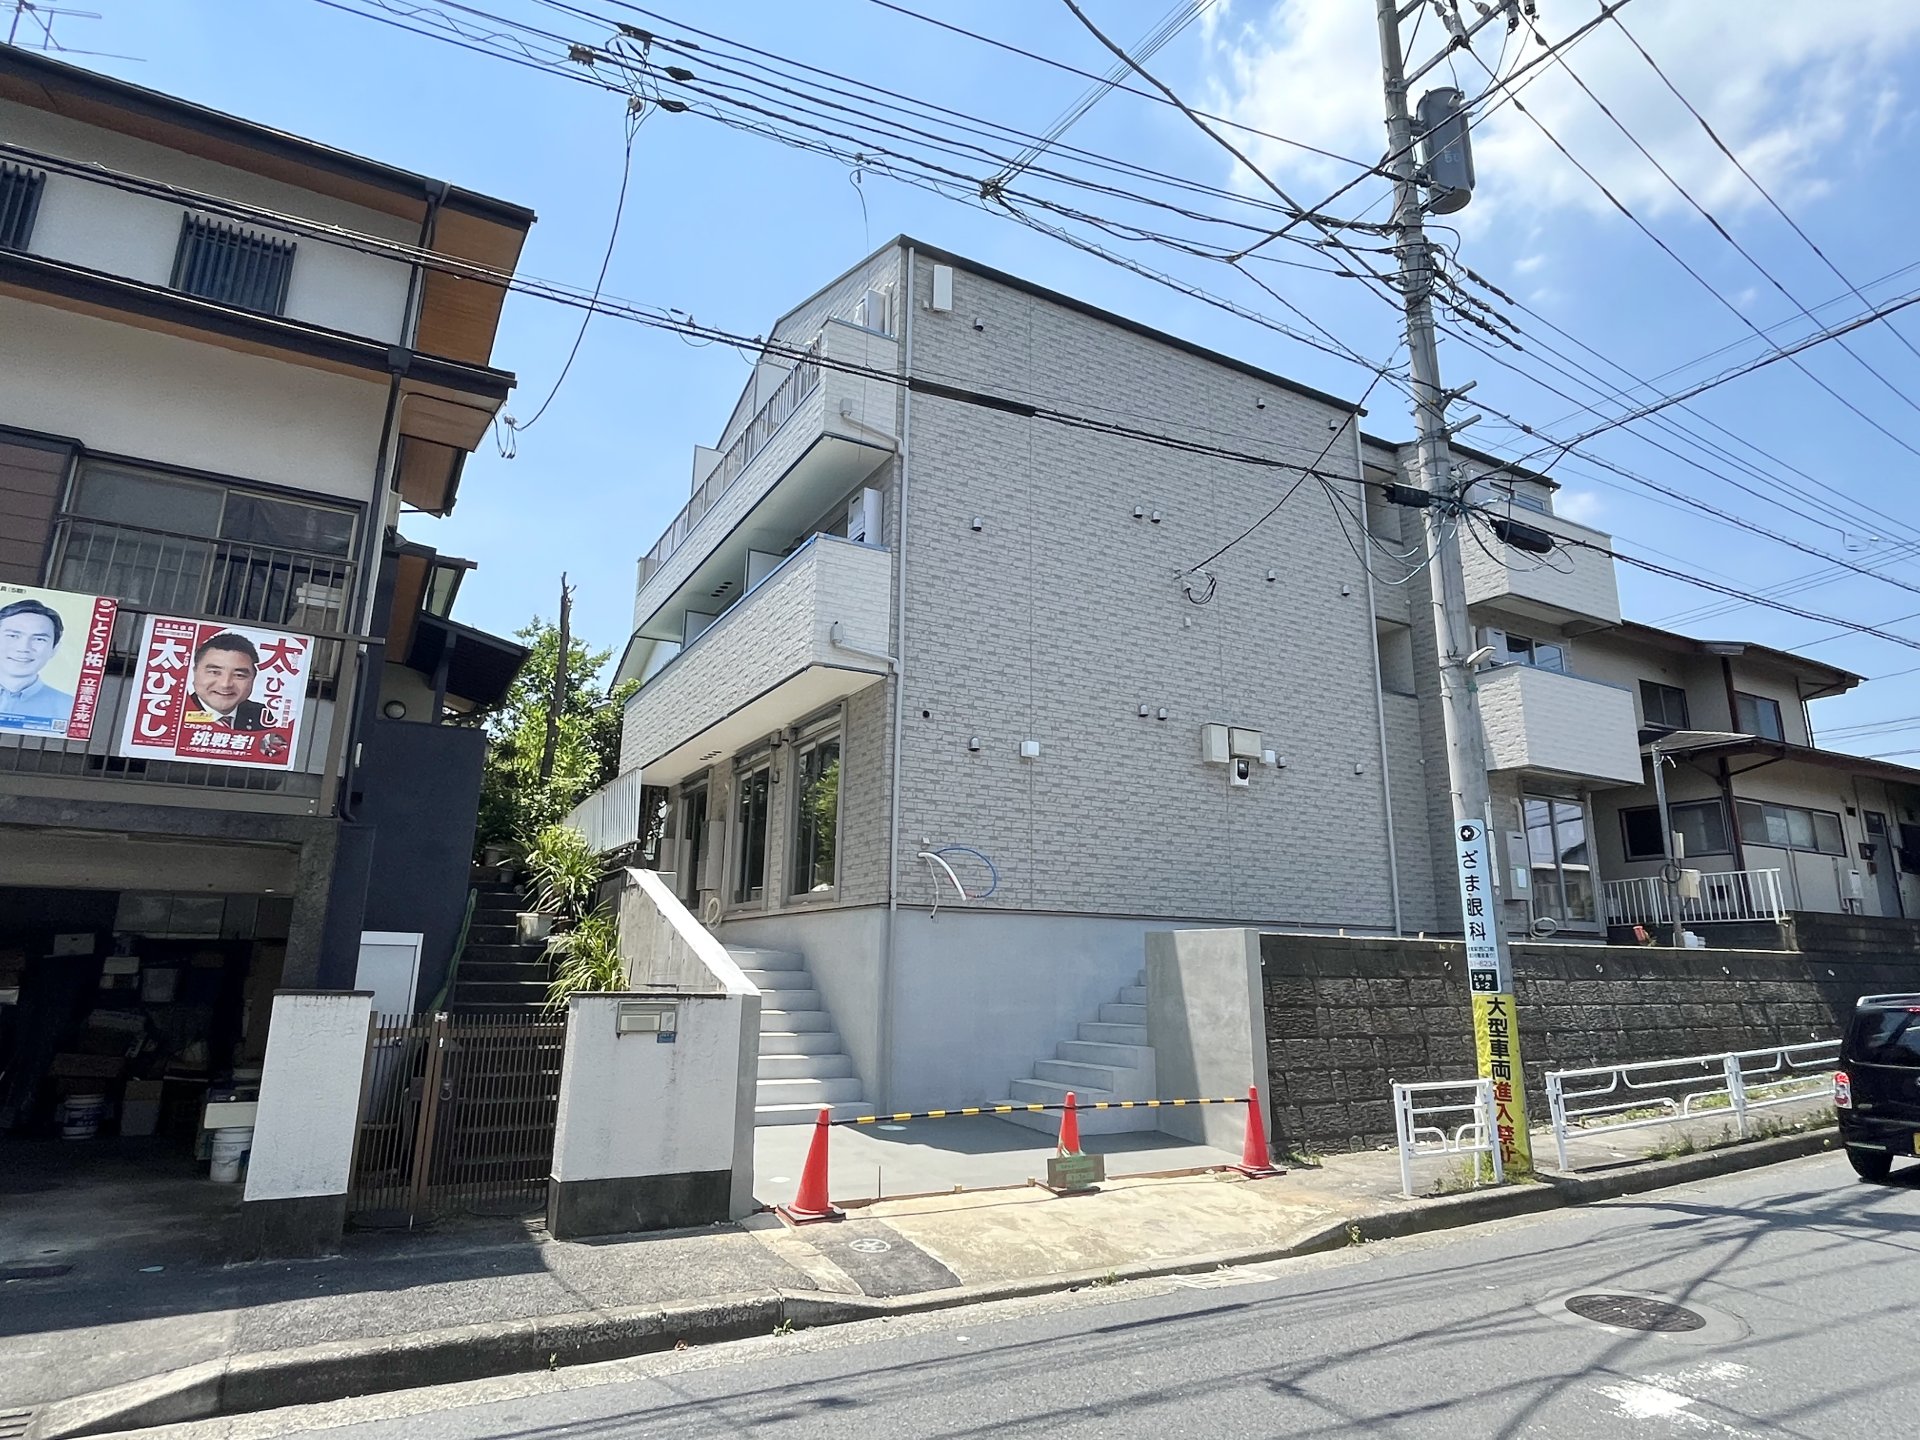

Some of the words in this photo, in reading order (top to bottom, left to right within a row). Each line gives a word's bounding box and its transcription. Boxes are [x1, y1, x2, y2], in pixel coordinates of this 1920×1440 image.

[140, 638, 187, 737] 太ひでし
[1461, 849, 1486, 942] ざま眼科
